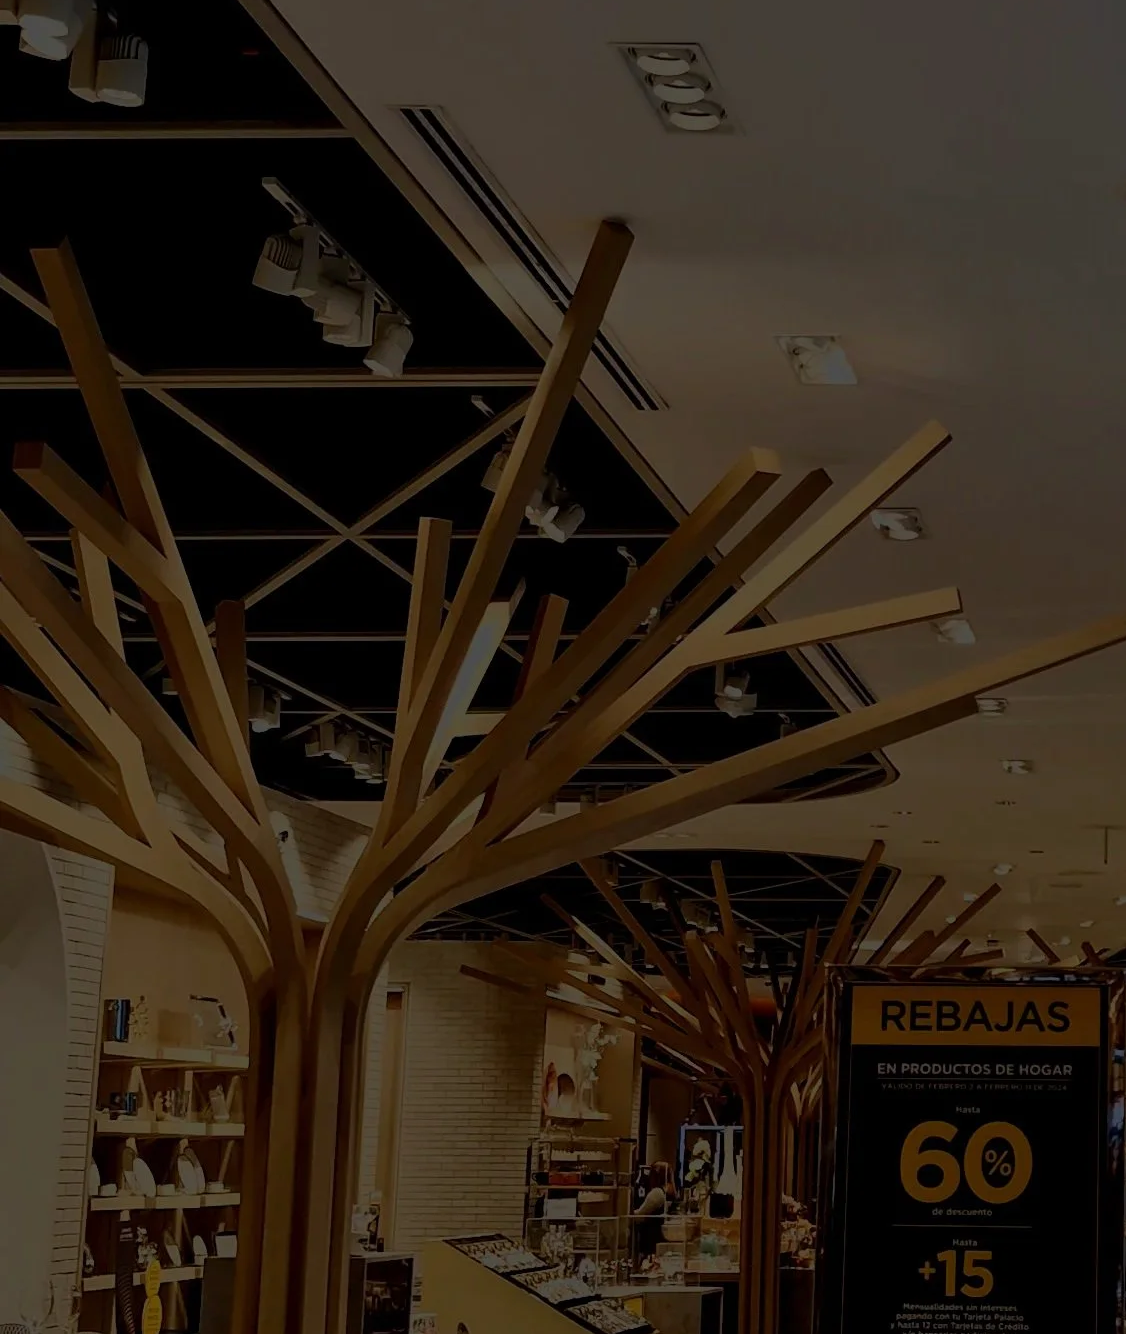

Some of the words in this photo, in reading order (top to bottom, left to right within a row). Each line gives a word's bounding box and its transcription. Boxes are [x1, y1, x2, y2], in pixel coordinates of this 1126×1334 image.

[881, 1000, 1070, 1033] REBAJAS
[877, 1062, 897, 1075] EN
[901, 1062, 991, 1076] PRODUCTOS
[996, 1063, 1015, 1076] DE
[1019, 1064, 1073, 1076] HOGAR
[955, 1105, 981, 1114] Hasta
[932, 1207, 943, 1216] de
[946, 1208, 993, 1217] descuento
[952, 1238, 978, 1247] Hasta
[918, 1249, 994, 1298] +15
[903, 1303, 963, 1311] Mensualidades
[966, 1303, 978, 1311] sin
[980, 1304, 1018, 1312] intereses
[895, 1313, 933, 1321] pagando
[963, 1313, 991, 1322] Tarjeta
[994, 1313, 1024, 1322] Palacio
[950, 1322, 983, 1331] Tarjetas
